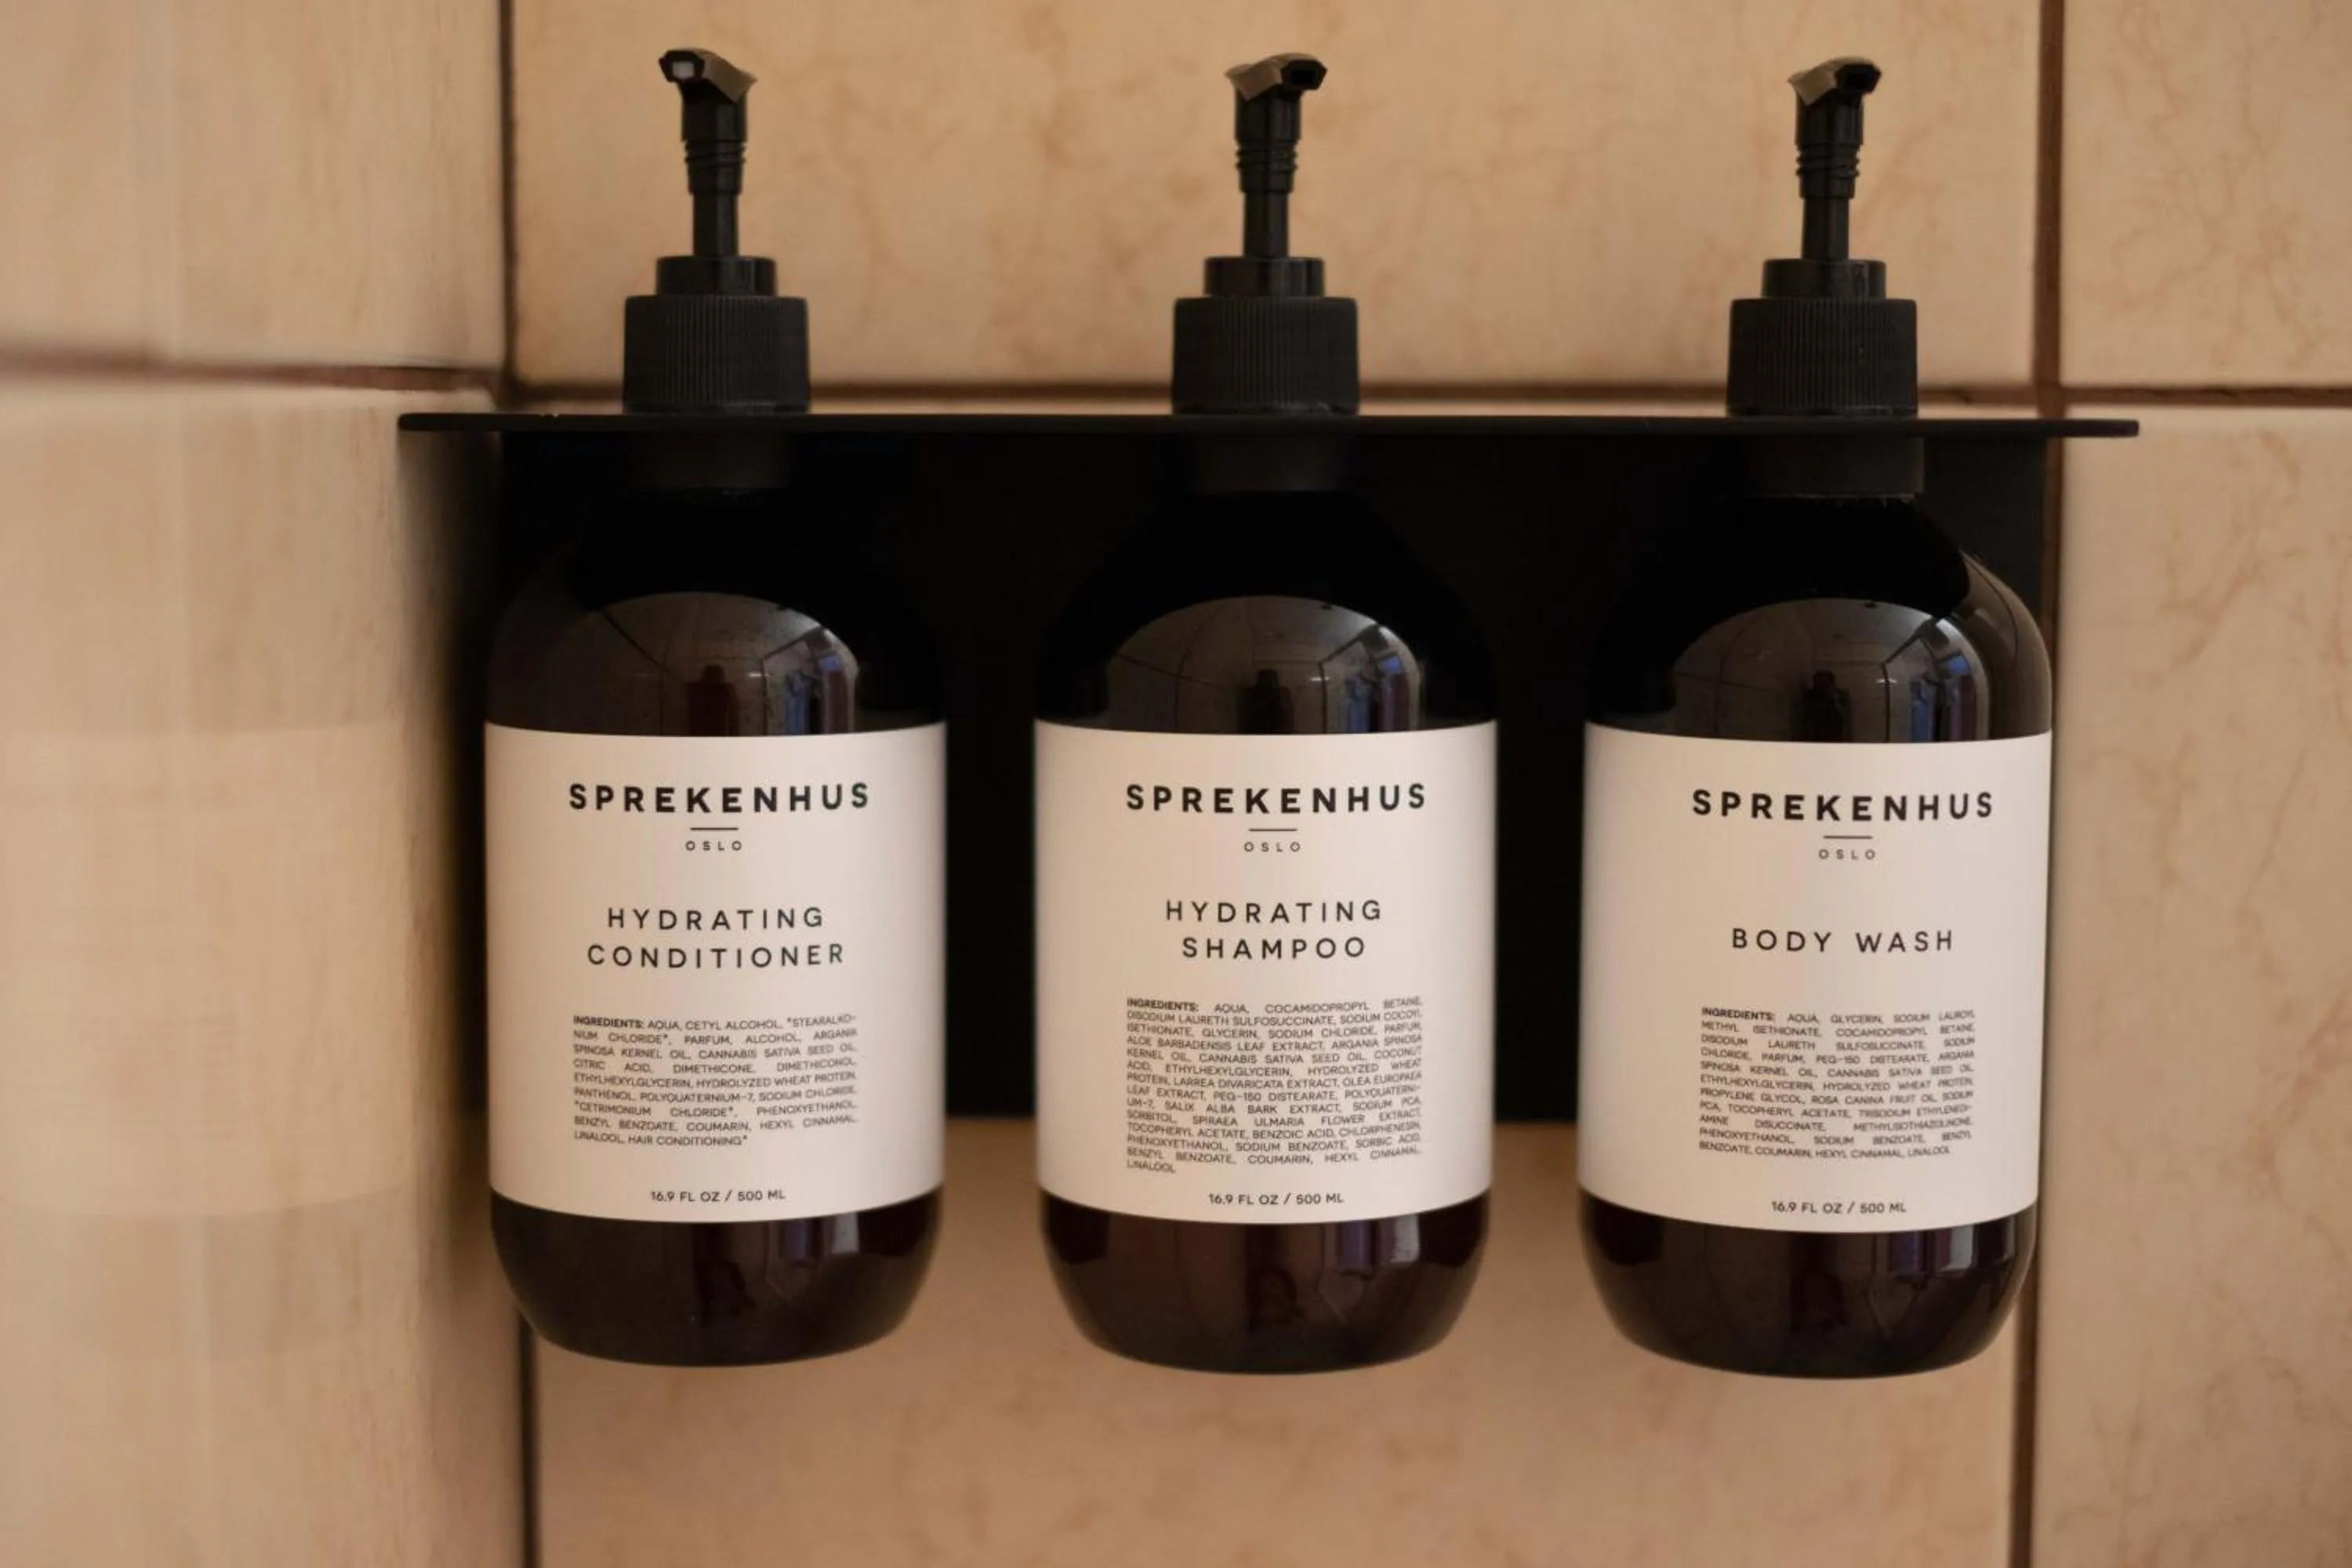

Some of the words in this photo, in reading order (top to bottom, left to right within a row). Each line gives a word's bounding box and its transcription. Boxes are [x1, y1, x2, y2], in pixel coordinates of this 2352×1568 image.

[569, 782, 869, 814] SPREKENHUS
[1126, 782, 1425, 815] SPREKENHUS
[1693, 789, 1992, 822] SPREKENHUS
[684, 840, 742, 852] OSLO
[1243, 840, 1301, 853] OSLO
[1818, 848, 1876, 861] OSLO
[1166, 899, 1381, 924] HYDRATING
[608, 906, 822, 931] HYDRATING
[1732, 927, 1831, 953] BODY
[1855, 930, 1952, 953] WASH
[1182, 936, 1365, 960] SHAMPOO
[587, 943, 843, 969] CONDITIONER
[685, 1020, 722, 1030] CETYL
[1178, 1014, 1229, 1025] LAURETH
[1340, 1012, 1381, 1024] SODIUM
[1268, 1029, 1313, 1039] SODIUM
[1157, 1037, 1232, 1051] BARBADENSIS
[1237, 1041, 1265, 1051] LEAF
[1330, 1037, 1378, 1050] ARGANIA
[621, 1047, 662, 1058] KERNEL
[699, 1048, 757, 1059] CANNABIS
[764, 1046, 801, 1058] SATIVA
[1199, 1052, 1258, 1064] CANNABIS
[1265, 1054, 1304, 1064] SATIVA
[1312, 1052, 1340, 1063] SEED
[1308, 1062, 1379, 1076] HYDROLYZED
[696, 1077, 771, 1088] HYDROLYZED
[774, 1074, 812, 1087] WHEAT
[1174, 1076, 1215, 1087] LARREA
[1218, 1079, 1284, 1089] DIVARICATA
[1342, 1076, 1371, 1087] OLEA
[758, 1090, 802, 1102] SODIUM
[1213, 1091, 1262, 1102] PEG-150
[1205, 1103, 1236, 1114] ALBA
[1247, 1105, 1278, 1114] BARK
[760, 1120, 793, 1131] HEXYL
[1192, 1115, 1239, 1127] SPIRAEA
[1254, 1117, 1305, 1127] ULMARIA
[1321, 1113, 1365, 1126] FLOWER
[628, 1134, 653, 1145] HAIR
[1252, 1130, 1304, 1139] BENZOIC
[1236, 1142, 1280, 1152] SODIUM
[1325, 1152, 1358, 1163] HEXYL
[650, 1191, 675, 1203] 16.9
[680, 1192, 696, 1202] FL
[700, 1191, 722, 1203] OZ
[724, 1189, 733, 1203] /
[736, 1189, 763, 1202] 500
[768, 1189, 786, 1201] ML
[1208, 1193, 1233, 1205] 16.9
[1237, 1194, 1254, 1205] FL
[1258, 1194, 1279, 1206] OZ
[1283, 1192, 1292, 1206] /
[1295, 1192, 1322, 1205] 500
[1326, 1192, 1344, 1203] ML
[1771, 1201, 1797, 1213] 16.9
[1801, 1202, 1818, 1214] FL
[1822, 1202, 1843, 1214] OZ
[1847, 1201, 1856, 1214] /
[1859, 1203, 1886, 1214] 500
[1889, 1203, 1907, 1214] ML
